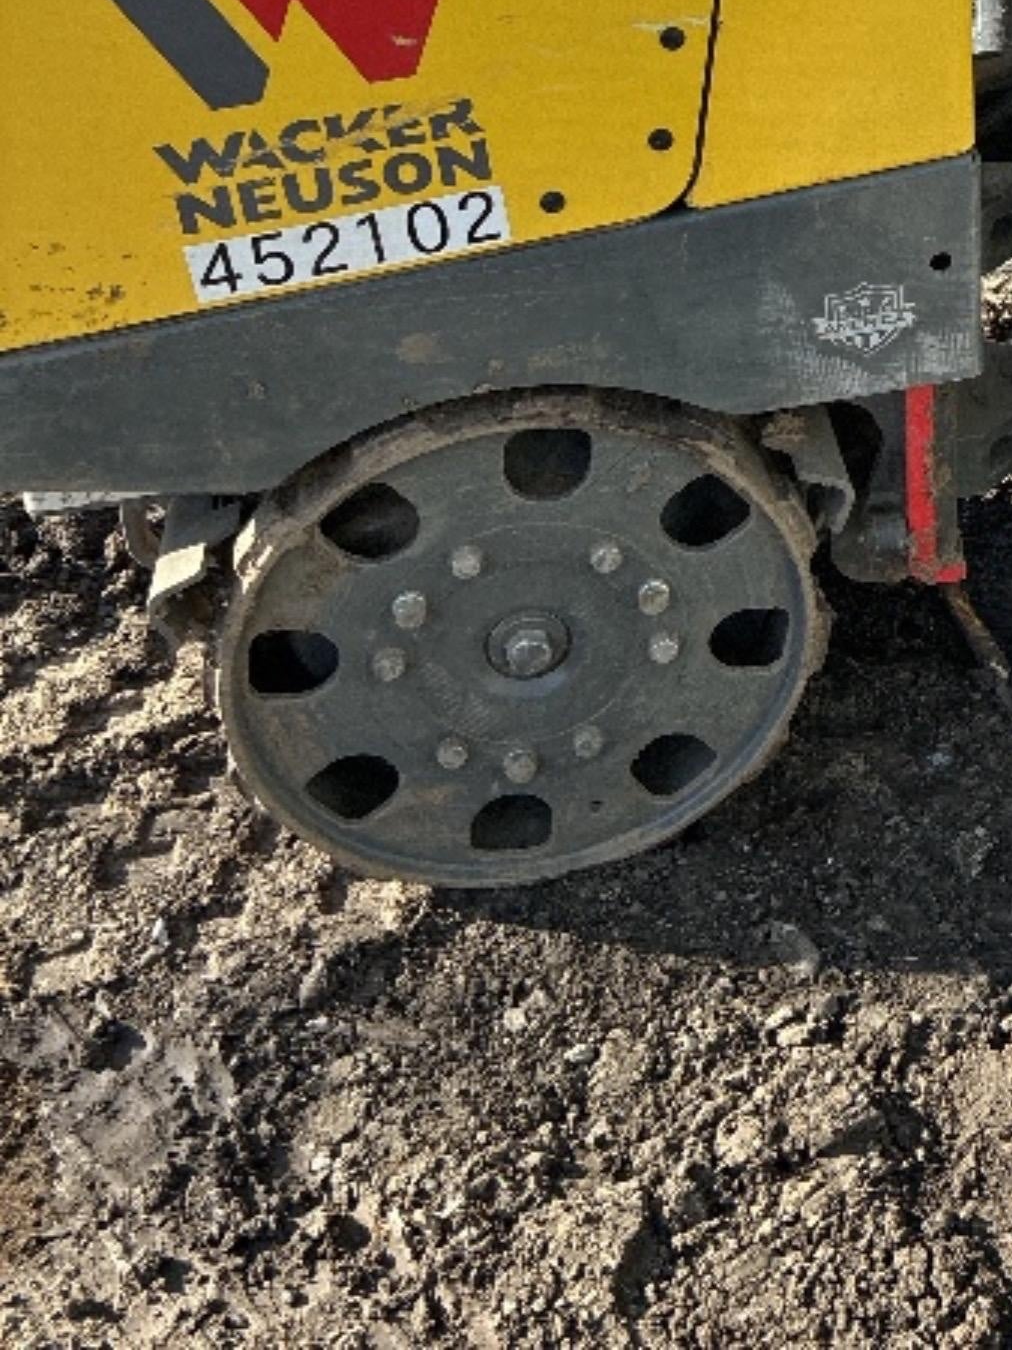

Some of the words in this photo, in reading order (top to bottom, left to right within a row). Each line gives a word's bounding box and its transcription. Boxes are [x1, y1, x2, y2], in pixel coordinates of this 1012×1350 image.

[152, 98, 486, 186] WACKER
[175, 138, 492, 234] NEUSON
[200, 191, 501, 294] 452102
